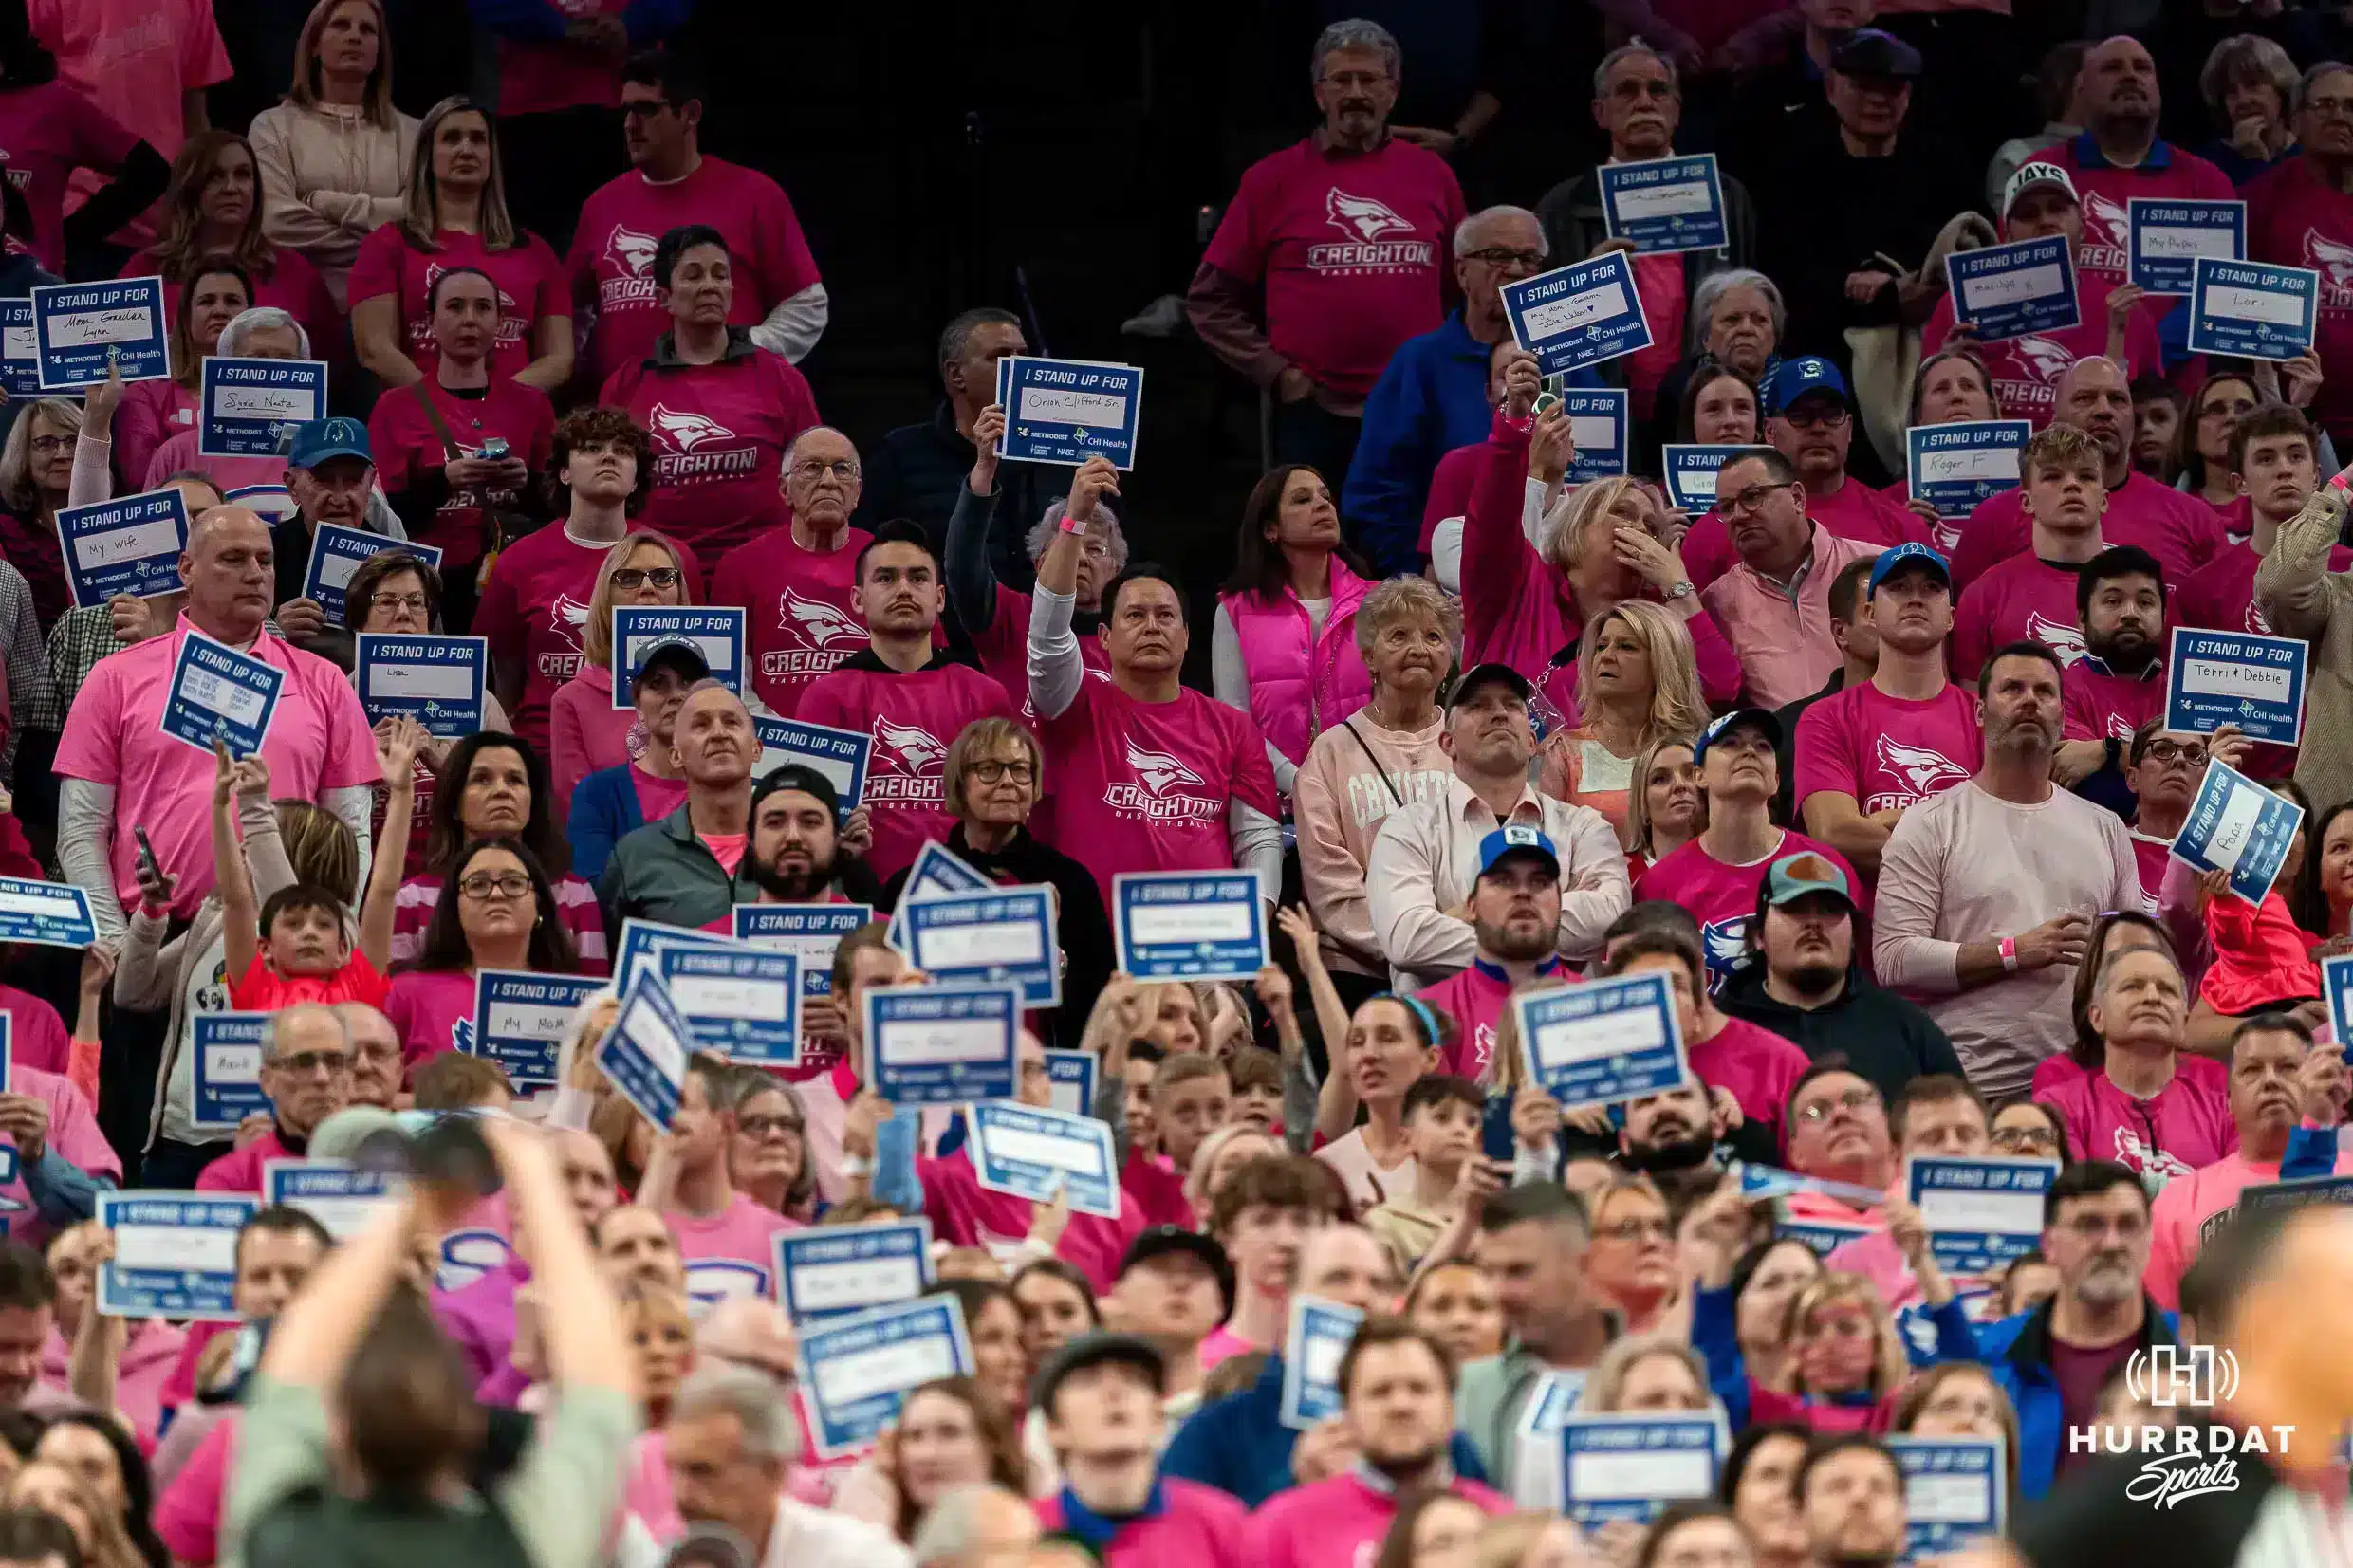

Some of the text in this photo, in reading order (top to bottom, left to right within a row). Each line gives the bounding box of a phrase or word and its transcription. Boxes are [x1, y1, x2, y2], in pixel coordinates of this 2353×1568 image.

[1622, 171, 1658, 185] STAND
[1663, 168, 1677, 179] UP
[1682, 164, 1705, 177] FOR
[2141, 209, 2235, 221] I STAND UP FOR
[1312, 244, 1432, 266] CREIGHTON
[1962, 246, 2057, 273] I STAND UP FOR
[1518, 264, 1616, 304] I STAND UP FOR
[2209, 267, 2307, 289] I STAND UP FOR
[48, 287, 150, 308] I STAND UP FOR
[602, 280, 656, 302] CREIGH
[14, 309, 34, 321] STA
[65, 315, 93, 328] Mom
[1602, 322, 1640, 339] CHI Health
[120, 348, 161, 360] CHI Health
[1547, 338, 1583, 353] METHODIST
[63, 353, 102, 362] METHODIST
[216, 367, 316, 382] I STAND UP FOR
[1025, 368, 1129, 389] I STAND UP FOR
[1029, 395, 1061, 408] Orion
[1571, 399, 1614, 411] UP FOR
[1029, 430, 1068, 440] METHODIST
[1087, 437, 1128, 450] CHI Health
[1921, 431, 2019, 447] I STAND UP FOR
[654, 450, 754, 475] EIGHTON
[1929, 455, 1964, 472] Roger
[73, 501, 172, 530] I STAND UP FOR
[89, 544, 104, 558] My
[337, 539, 379, 556] STAND
[95, 572, 131, 584] METHODIST
[628, 618, 732, 629] I STAND UP FOR
[372, 644, 474, 658] I STAND UP FOR
[647, 636, 695, 650] BLUEJAYS
[2187, 640, 2295, 662] I STAND UP FOR
[198, 651, 232, 672] STAND
[233, 663, 249, 679] UP
[249, 671, 272, 690] FOR
[763, 652, 845, 673] CREIGH
[2194, 664, 2228, 678] Terri
[2244, 669, 2282, 685] Debbie
[436, 710, 477, 720] CHI Health
[2194, 704, 2233, 713] METHODIST
[2253, 711, 2293, 723] CHI Health
[767, 729, 806, 746] STAND
[810, 737, 828, 748] UP
[831, 740, 857, 756] FOR
[862, 779, 944, 798] CREIGH
[1108, 786, 1219, 820] CREIGHTON
[2194, 808, 2216, 842] STAND
[2209, 790, 2222, 808] UP
[2216, 772, 2231, 793] FOR
[1116, 810, 1207, 829] BASKETBALL
[759, 915, 803, 929] STAND
[807, 915, 826, 929] UP
[831, 915, 858, 929] FOR
[502, 983, 545, 999] STAND
[549, 987, 567, 1000] UP
[571, 988, 587, 1001] FO
